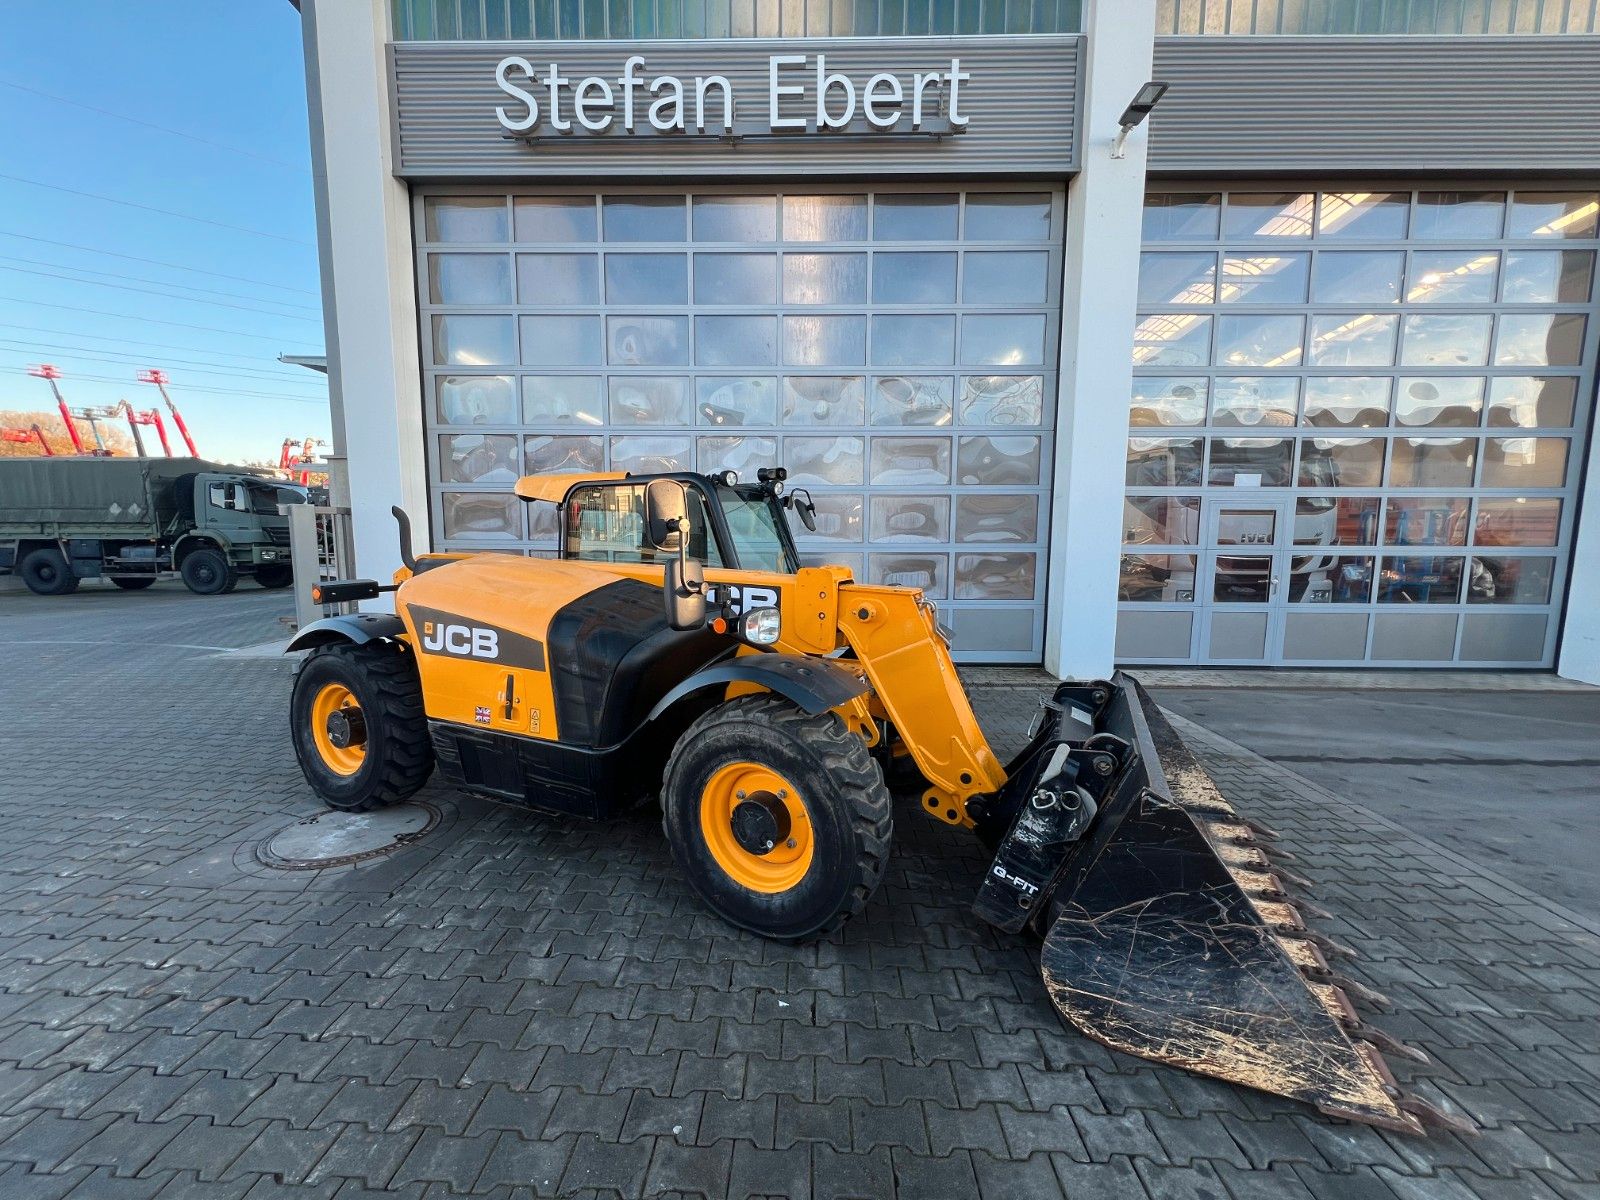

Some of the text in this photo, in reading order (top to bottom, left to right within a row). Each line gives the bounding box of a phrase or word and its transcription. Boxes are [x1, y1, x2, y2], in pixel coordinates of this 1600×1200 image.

[495, 54, 970, 133] Stefan Ebert
[424, 622, 499, 659] JCB
[993, 865, 1039, 895] Q-FIT
